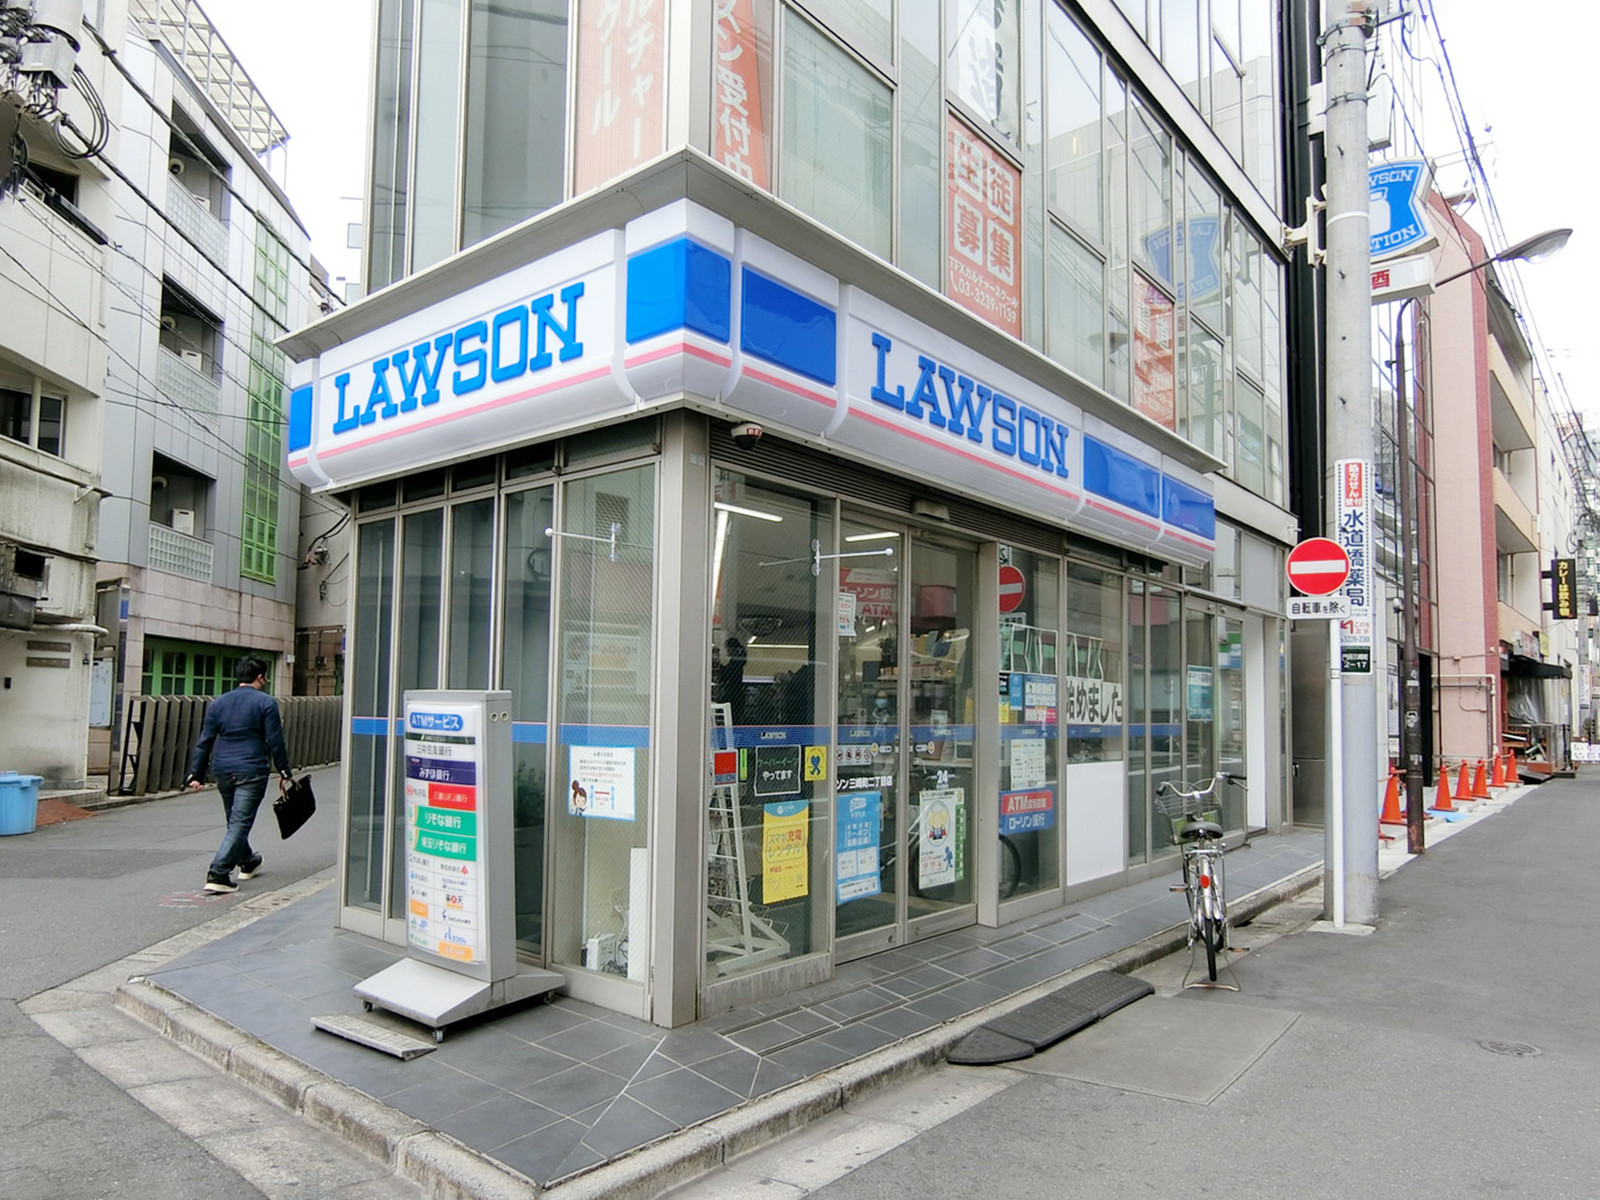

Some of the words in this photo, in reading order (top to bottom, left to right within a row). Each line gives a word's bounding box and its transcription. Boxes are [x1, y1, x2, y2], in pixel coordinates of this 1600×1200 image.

[333, 281, 585, 435] LAWSON
[870, 332, 1069, 479] LAWSON
[862, 604, 893, 616] ATM
[1291, 601, 1346, 614] 自転車を除く
[1343, 661, 1368, 669] 2-17
[411, 715, 461, 729] ATMサービス
[418, 767, 450, 781] みずほ銀行
[762, 769, 793, 781] やってます
[424, 811, 462, 829] りそな銀行
[1008, 812, 1046, 830] ローソン銀行
